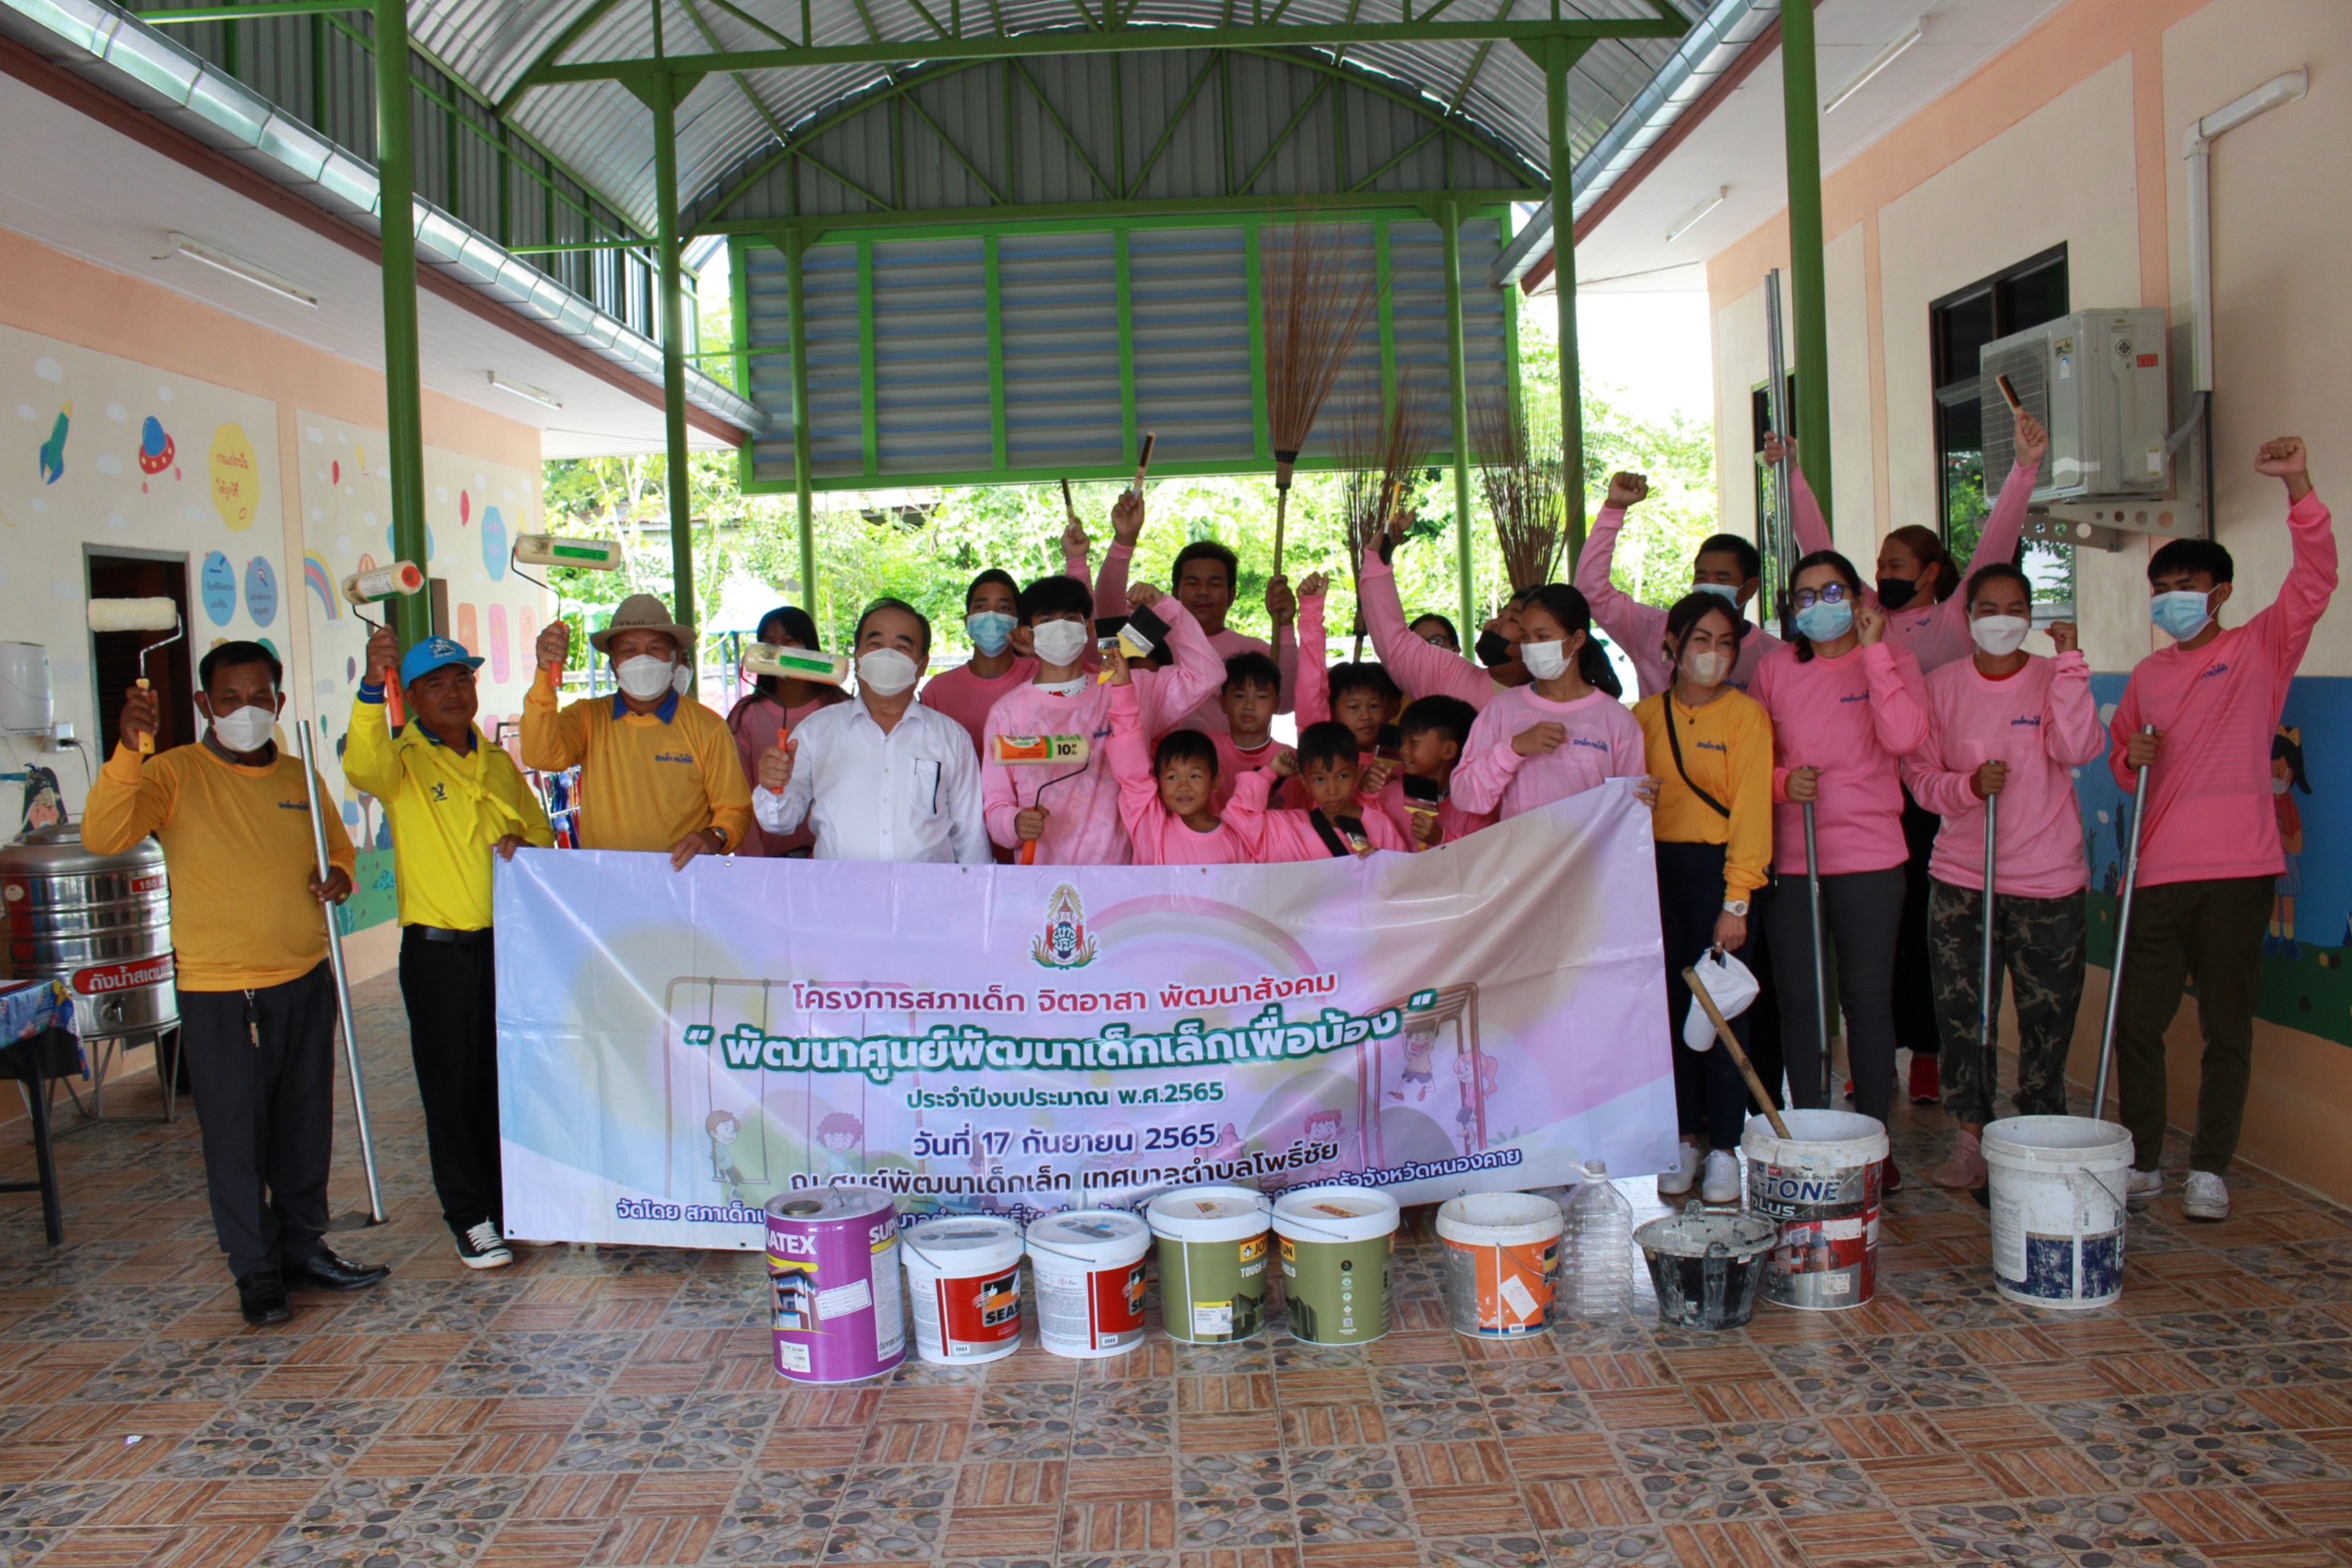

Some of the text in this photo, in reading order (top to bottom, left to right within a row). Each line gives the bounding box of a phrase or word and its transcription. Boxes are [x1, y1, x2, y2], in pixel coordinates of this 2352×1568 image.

[792, 972, 1336, 1013] โครงการสภาเด็ก จิตอาสา พัฒนาสังคม
[723, 1004, 1398, 1082] พัฒนาศูนย์พัฒนาเด็กเล็กเพื่อน้อง
[906, 1080, 1225, 1109] ประจำปีงบประมาณ พ.ศ.2565
[913, 1123, 1216, 1156] วันที่ 17 กันยายน 2565
[1083, 1140, 1339, 1190] เทศบาลตำบลโพธิ์ชัย
[617, 1199, 681, 1220] จัดโดย
